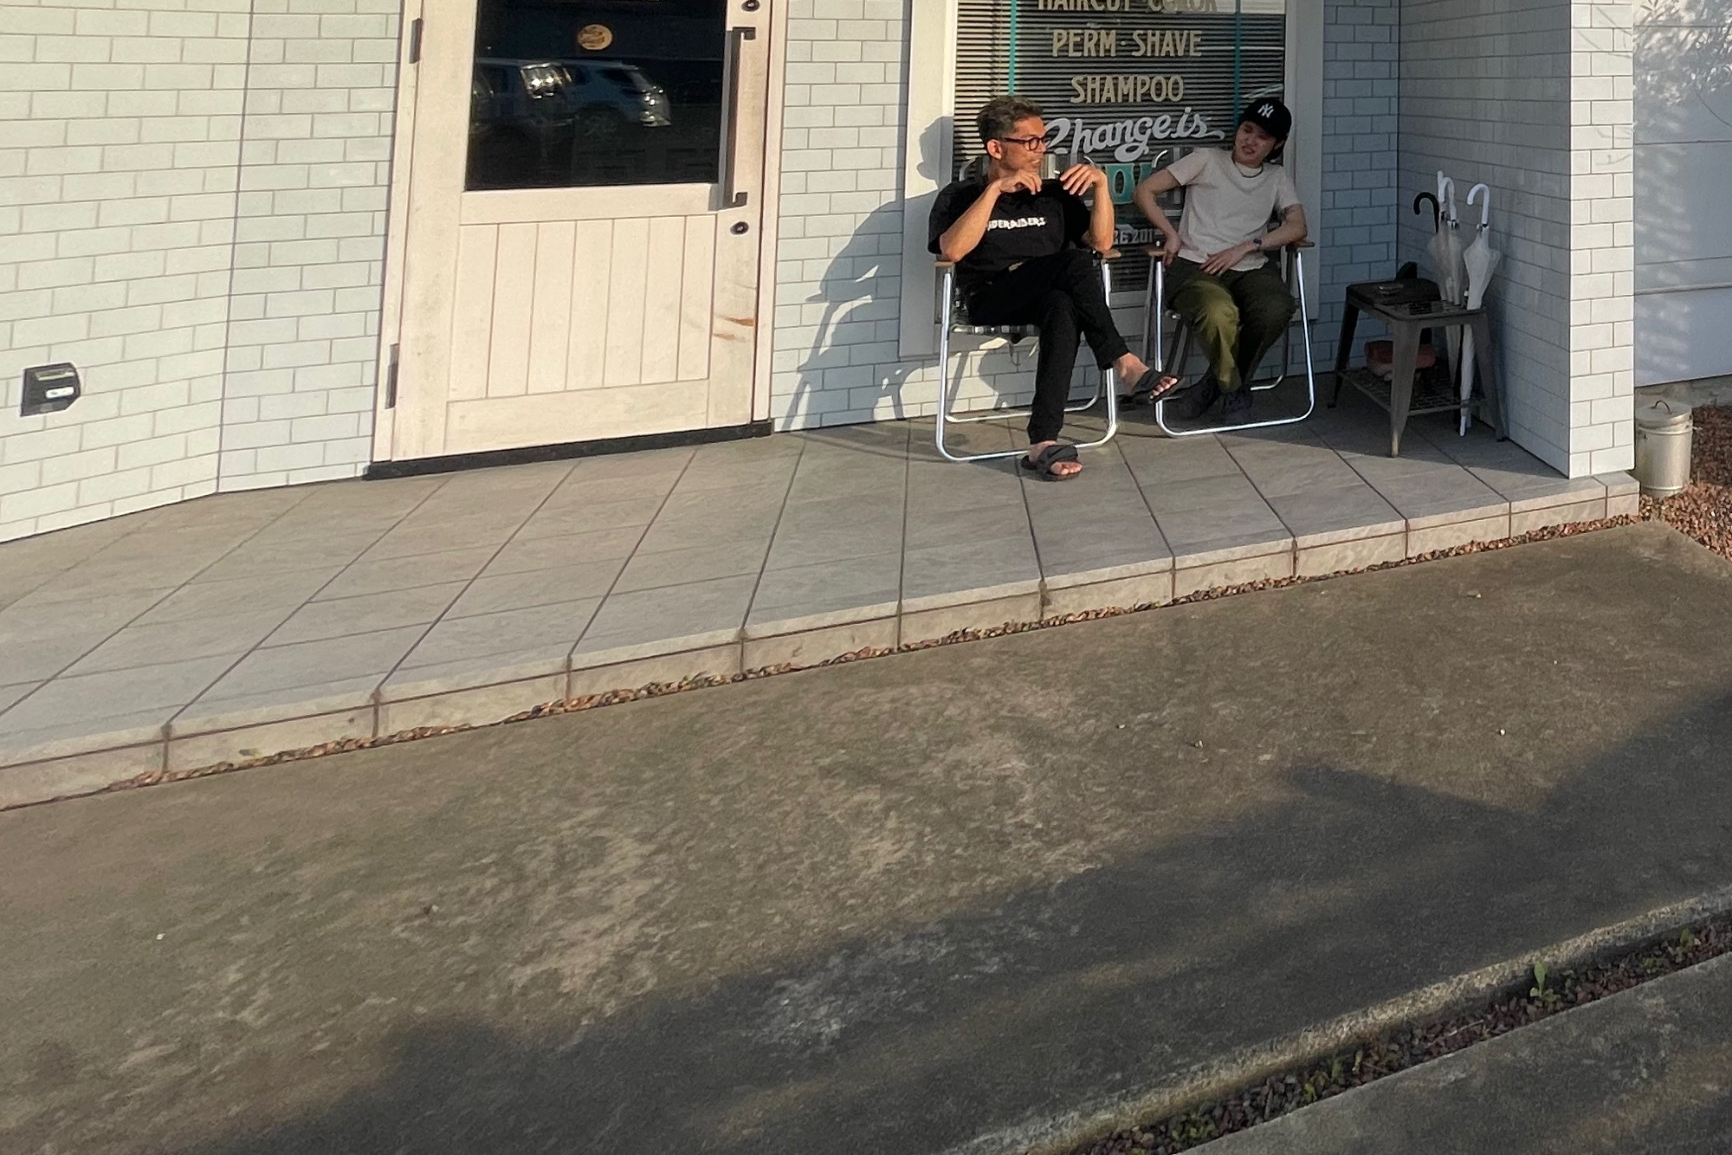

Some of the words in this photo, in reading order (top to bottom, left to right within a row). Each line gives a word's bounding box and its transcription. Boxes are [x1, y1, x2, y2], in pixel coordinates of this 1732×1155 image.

[1052, 29, 1117, 57] PERM
[1132, 29, 1203, 57] SHAVE
[1070, 75, 1184, 104] SHAMPOO
[1172, 106, 1225, 141] is
